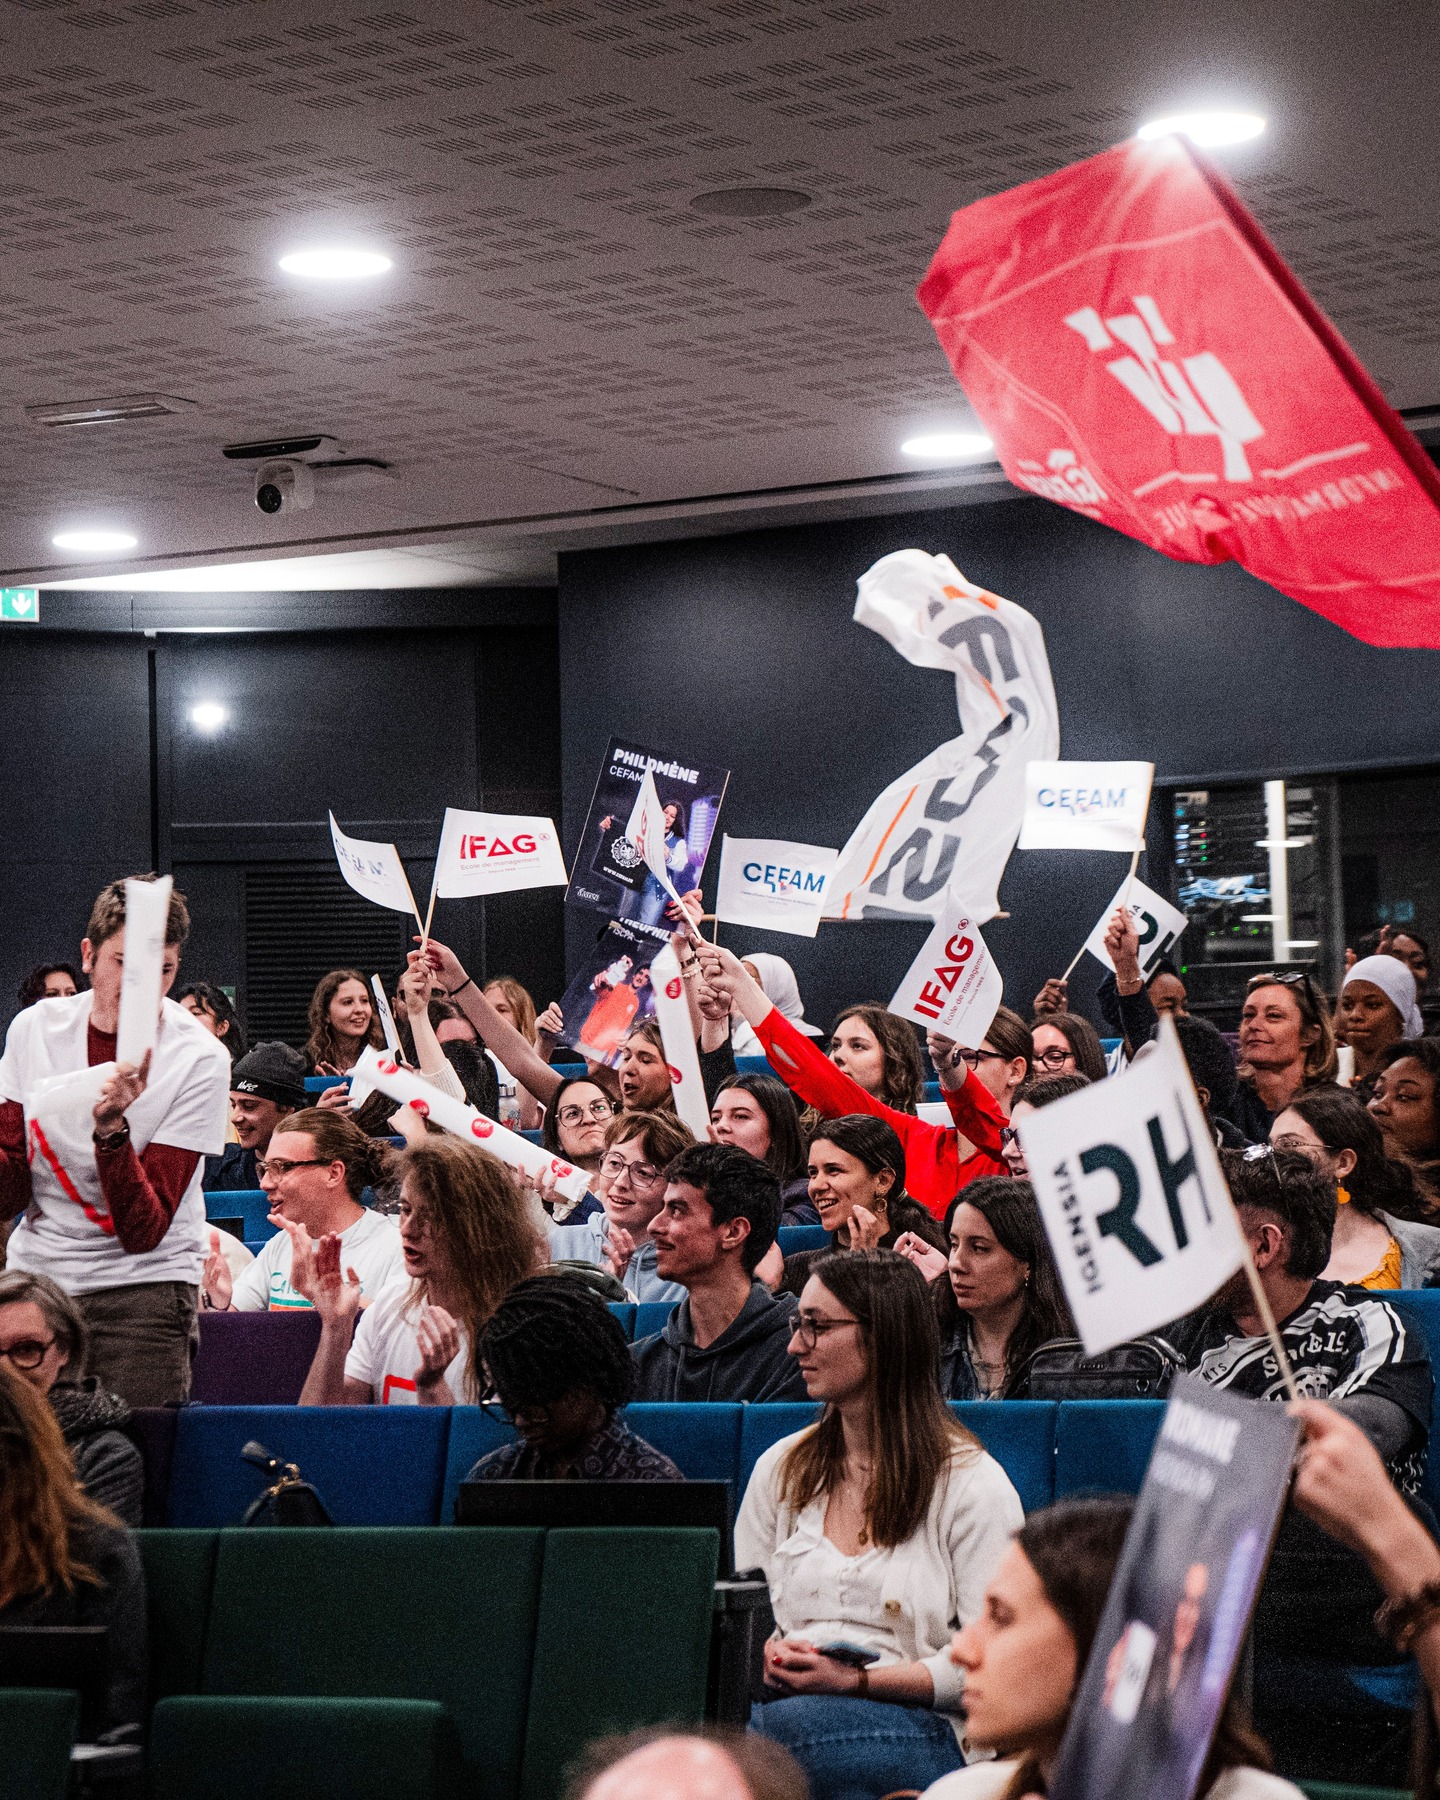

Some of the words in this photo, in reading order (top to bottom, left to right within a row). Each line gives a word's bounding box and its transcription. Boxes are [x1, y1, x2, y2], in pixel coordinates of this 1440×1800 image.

[609, 765, 644, 783] CEFAM
[613, 748, 699, 784] PHILOMÈNE
[1037, 787, 1127, 816] CEFAM
[460, 834, 537, 859] IFAG
[460, 863, 480, 871] Ecole
[493, 857, 540, 867] management
[743, 862, 826, 893] CEFAM
[913, 933, 974, 1020] IFAG
[943, 1005, 958, 1026] Ecole
[956, 994, 965, 1005] de
[963, 946, 986, 994] management
[1079, 1088, 1213, 1268] RH
[1054, 1159, 1105, 1296] IGENSIA
